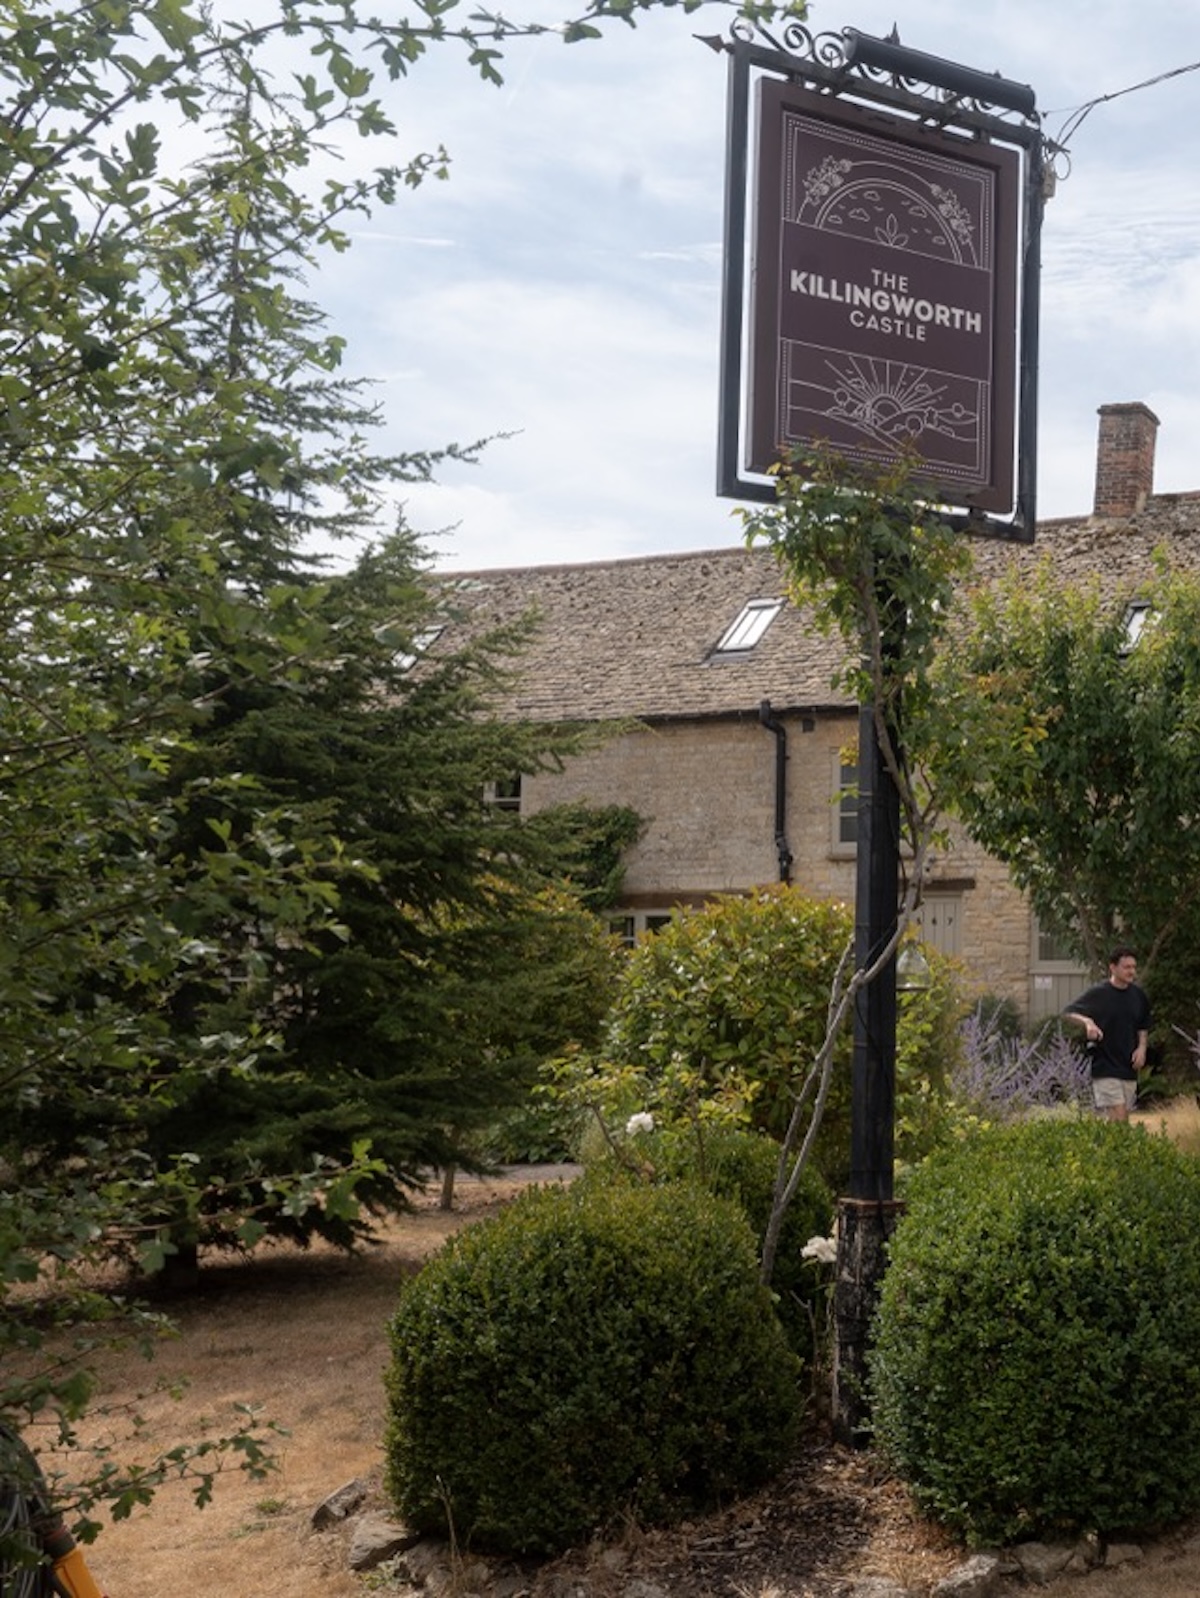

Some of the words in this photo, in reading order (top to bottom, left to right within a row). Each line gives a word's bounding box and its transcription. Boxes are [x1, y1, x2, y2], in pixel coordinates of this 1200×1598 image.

[871, 268, 908, 293] THE
[790, 269, 982, 334] KILLINGWORTH
[849, 310, 926, 342] CASTLE
